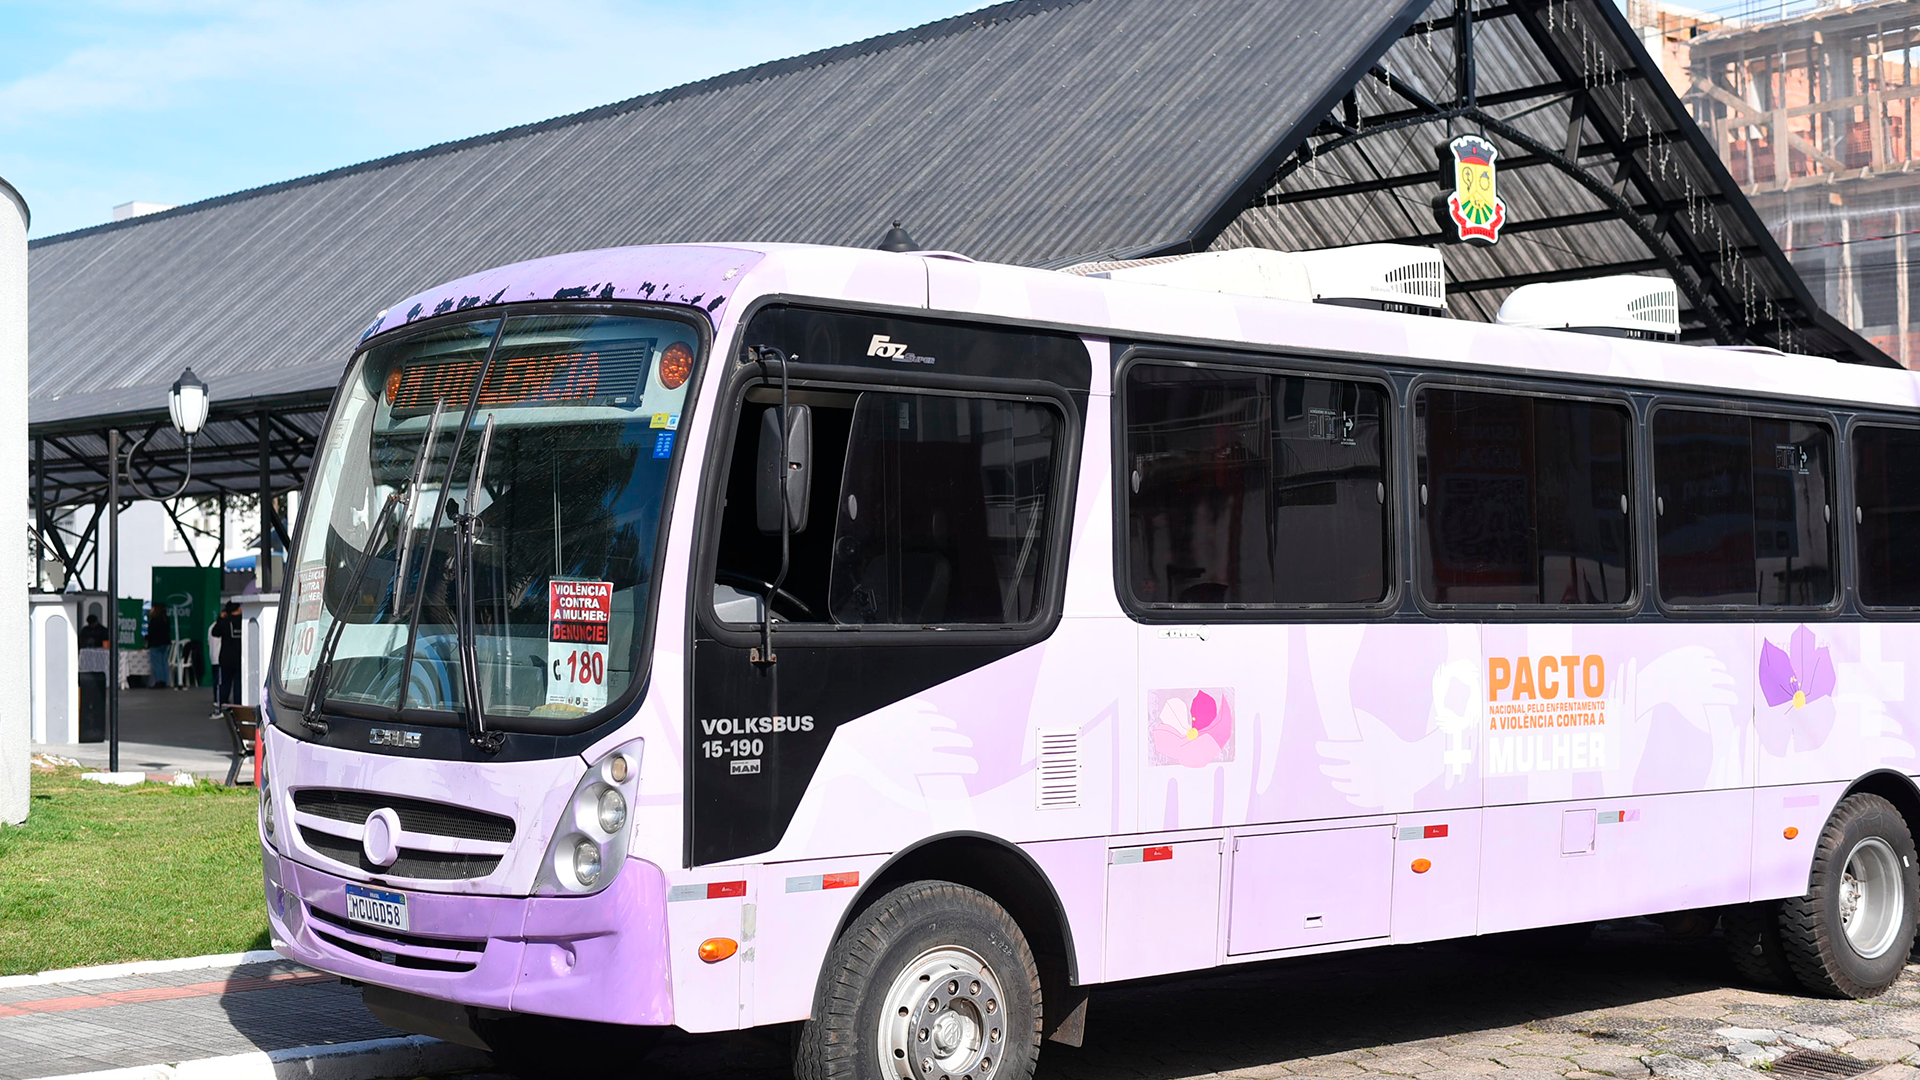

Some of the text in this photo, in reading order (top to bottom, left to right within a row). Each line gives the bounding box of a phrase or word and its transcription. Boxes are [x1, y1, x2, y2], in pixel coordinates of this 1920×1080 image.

[554, 583, 608, 597] VIOLÊNCIA
[560, 598, 600, 609] CONTRA
[553, 609, 607, 621] A MULHER:
[552, 623, 607, 642] DENUNCIE!
[567, 650, 604, 685] 180
[1488, 654, 1605, 702] PACTO
[1489, 701, 1605, 715] NACIONAL PELO ENFRENTAMENTO
[701, 716, 814, 735] VOLKSBUS
[1499, 713, 1554, 730] VIOLÊNCIA
[1556, 713, 1596, 728] CONTRA
[1598, 712, 1605, 725] A
[702, 739, 764, 758] 15-190
[1488, 732, 1606, 774] MULHER
[732, 764, 759, 773] MAN
